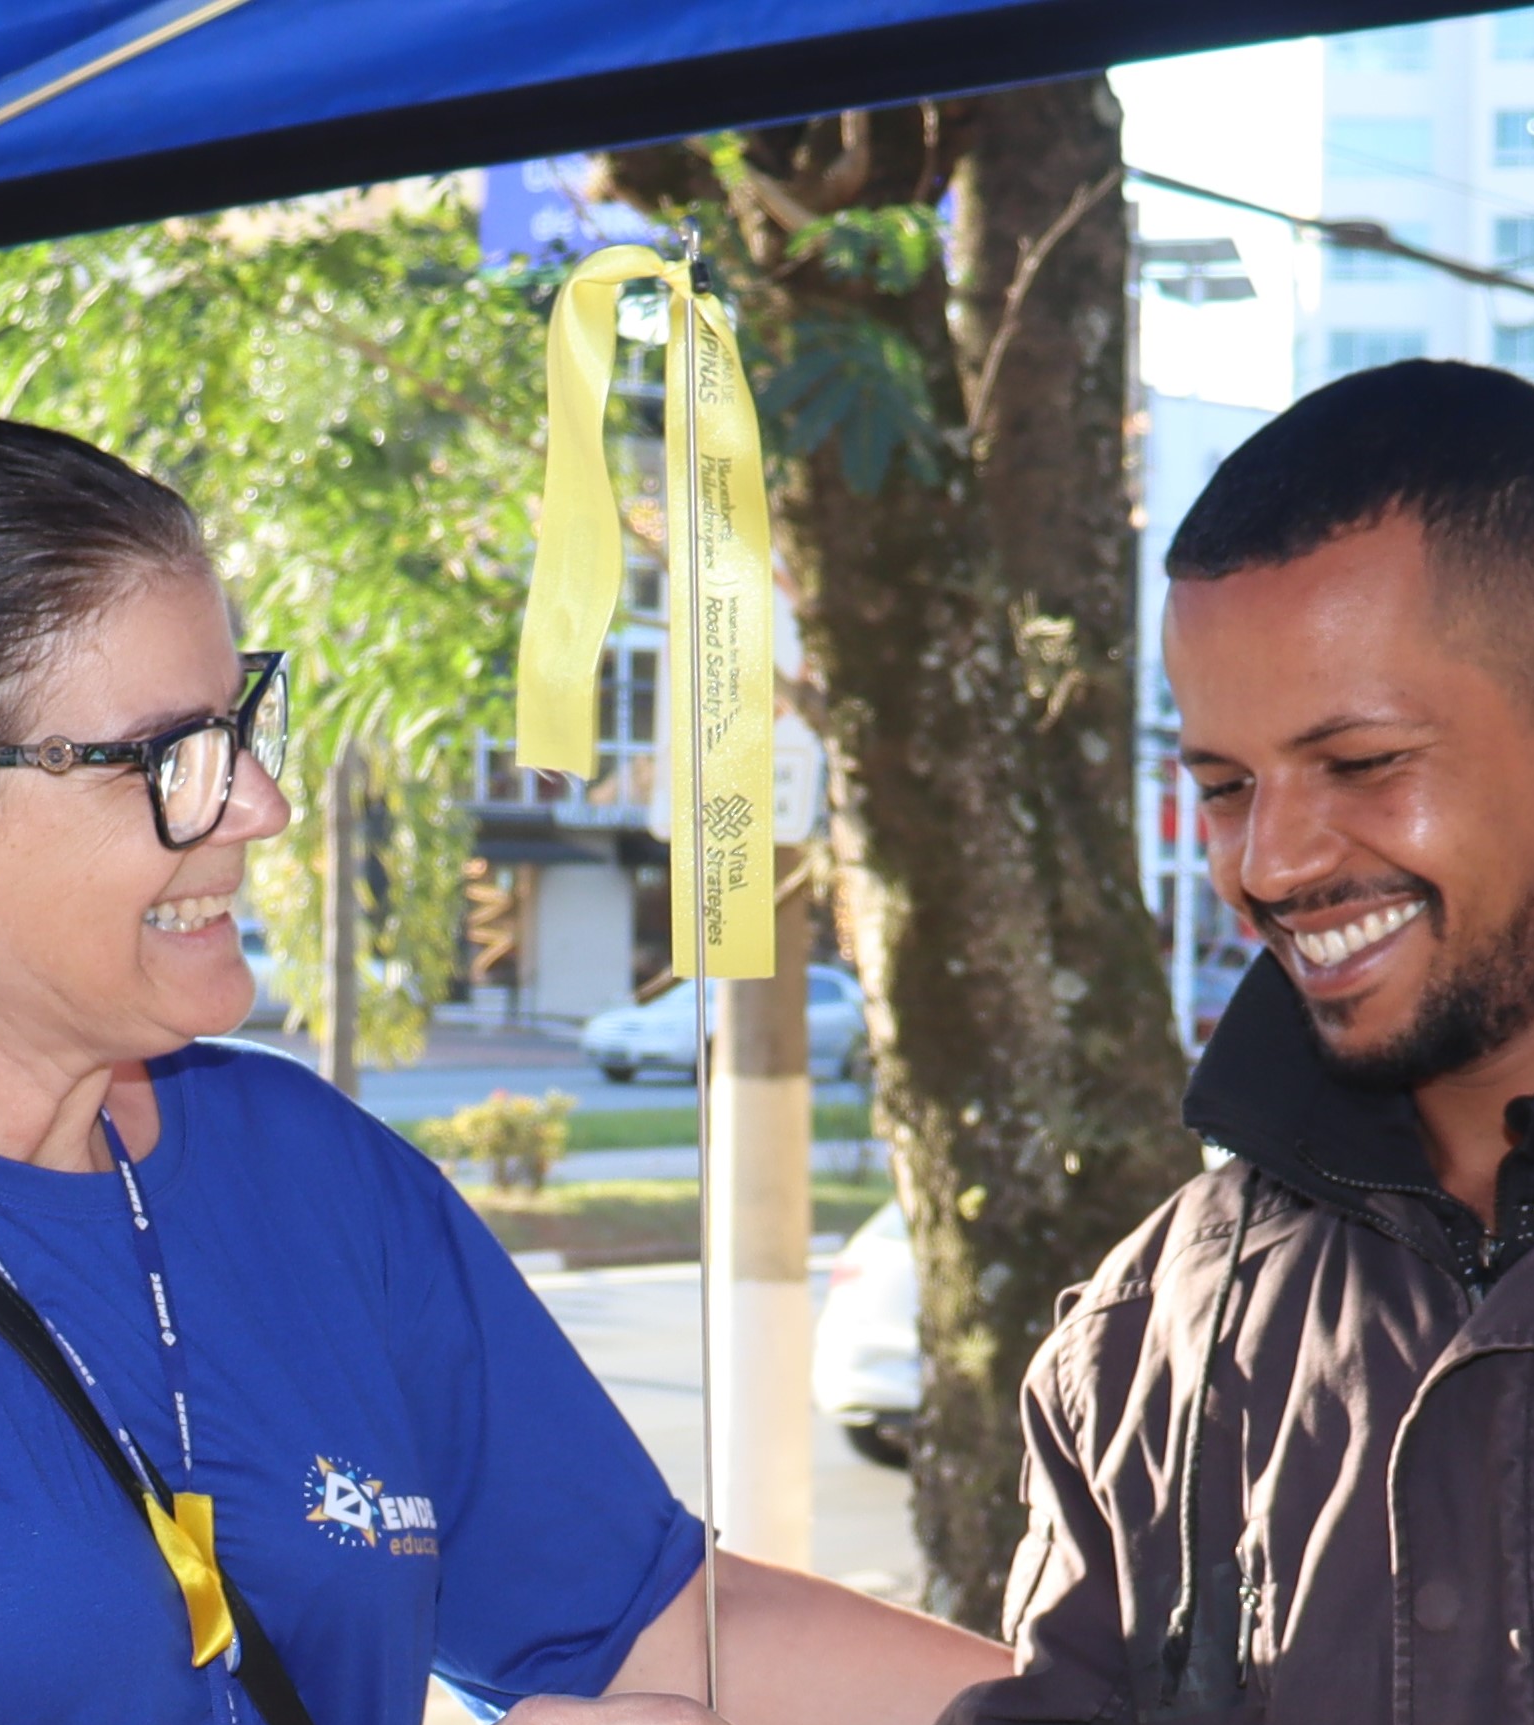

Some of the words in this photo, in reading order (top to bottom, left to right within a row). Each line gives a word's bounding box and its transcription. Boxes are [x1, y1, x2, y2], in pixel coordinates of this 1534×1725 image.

[698, 453, 719, 569] Philanthropies
[717, 457, 736, 542] Bloomberg
[706, 597, 723, 649] Road
[702, 653, 724, 718] Safety
[703, 847, 727, 946] Strategies
[729, 842, 749, 892] Vital
[122, 1160, 143, 1213] EMDEC
[149, 1272, 171, 1329] EMDEC
